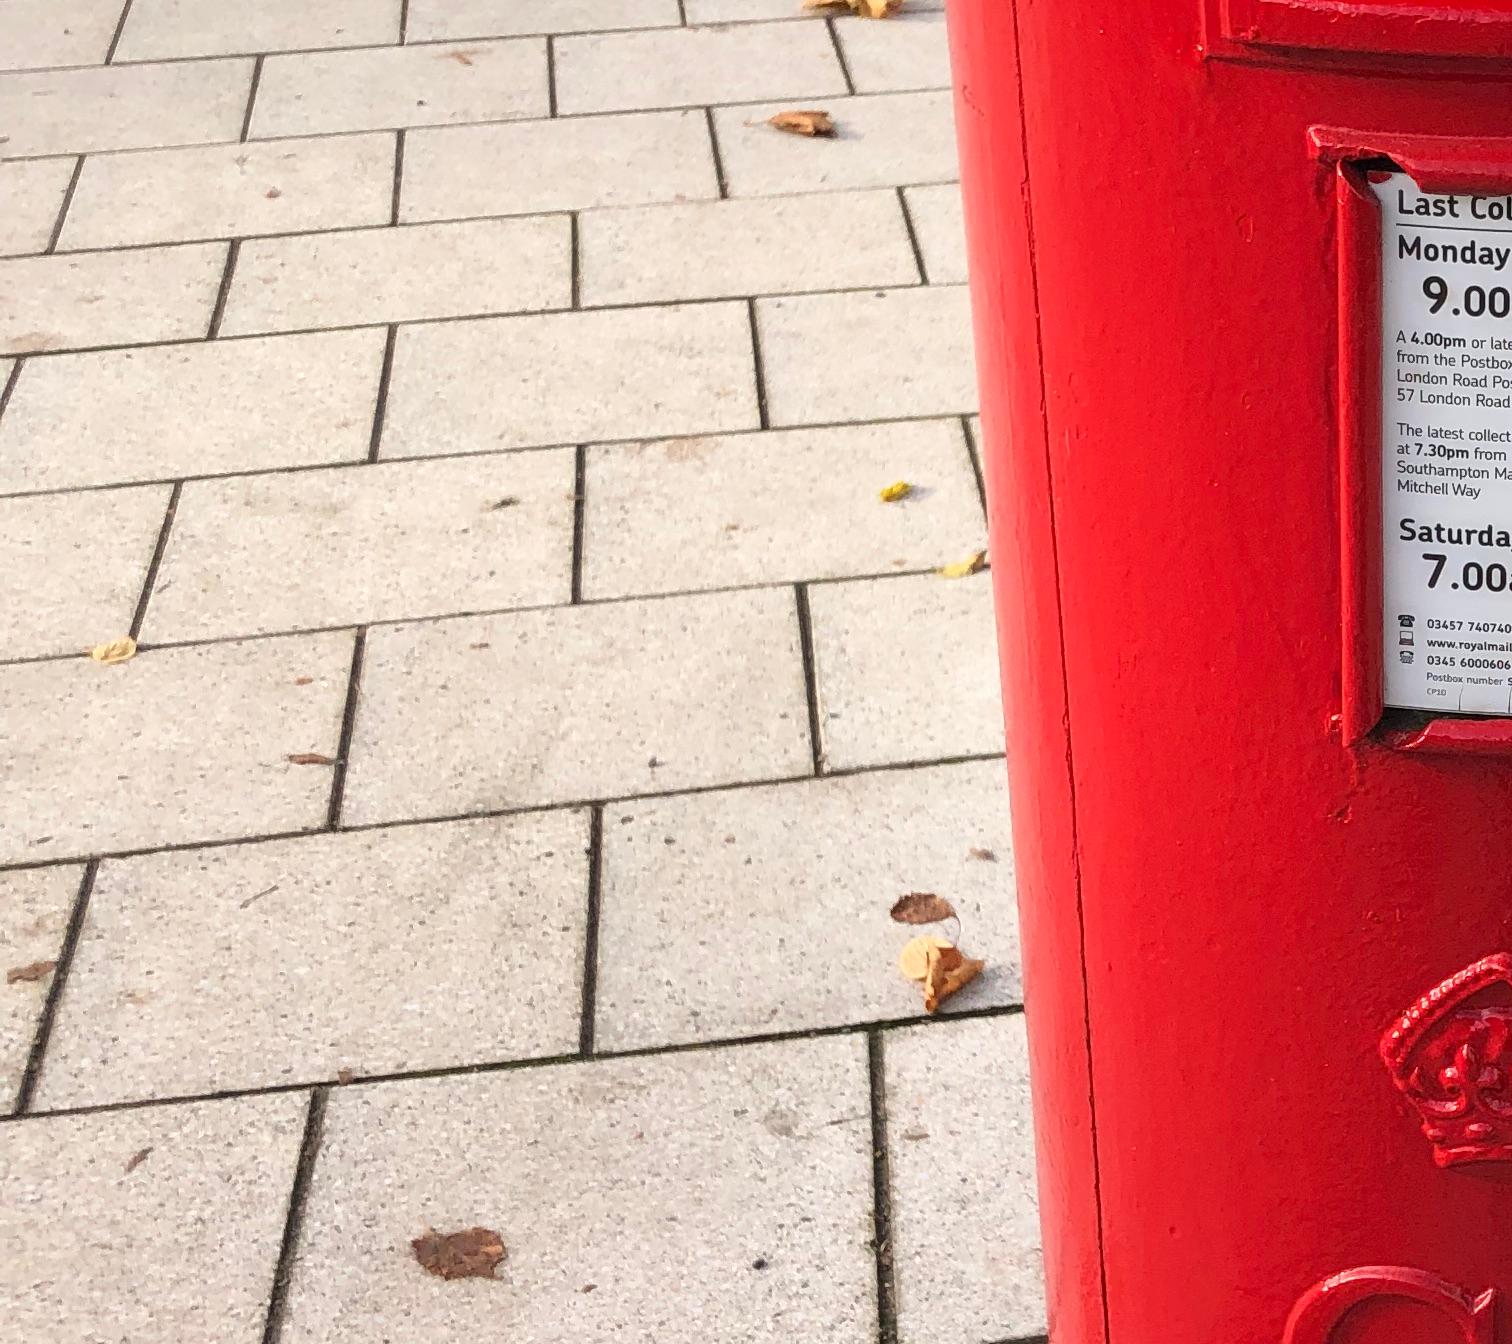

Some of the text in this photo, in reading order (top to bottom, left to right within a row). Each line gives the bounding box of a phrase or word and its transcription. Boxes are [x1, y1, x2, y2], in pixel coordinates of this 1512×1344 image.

[1398, 188, 1460, 219] Last
[1398, 234, 1511, 271] Monday
[1395, 330, 1407, 344] A
[1410, 331, 1467, 350] 4.00pm
[1471, 338, 1488, 350] or
[1396, 350, 1430, 365] from
[1433, 352, 1457, 367] the
[1396, 369, 1448, 386] London
[1452, 372, 1488, 389] Road
[1396, 387, 1511, 409] 57 London Road
[1396, 422, 1424, 438] The
[1427, 424, 1465, 441] latest
[1396, 442, 1507, 463] at 7.30pm from
[1396, 460, 1490, 483] Southampton
[1397, 479, 1482, 501] Mitchell Way
[1426, 618, 1512, 634] 03457 740740
[1426, 654, 1512, 671] 0345 6000606
[1426, 671, 1465, 686] Postbox
[1464, 674, 1505, 687] number
